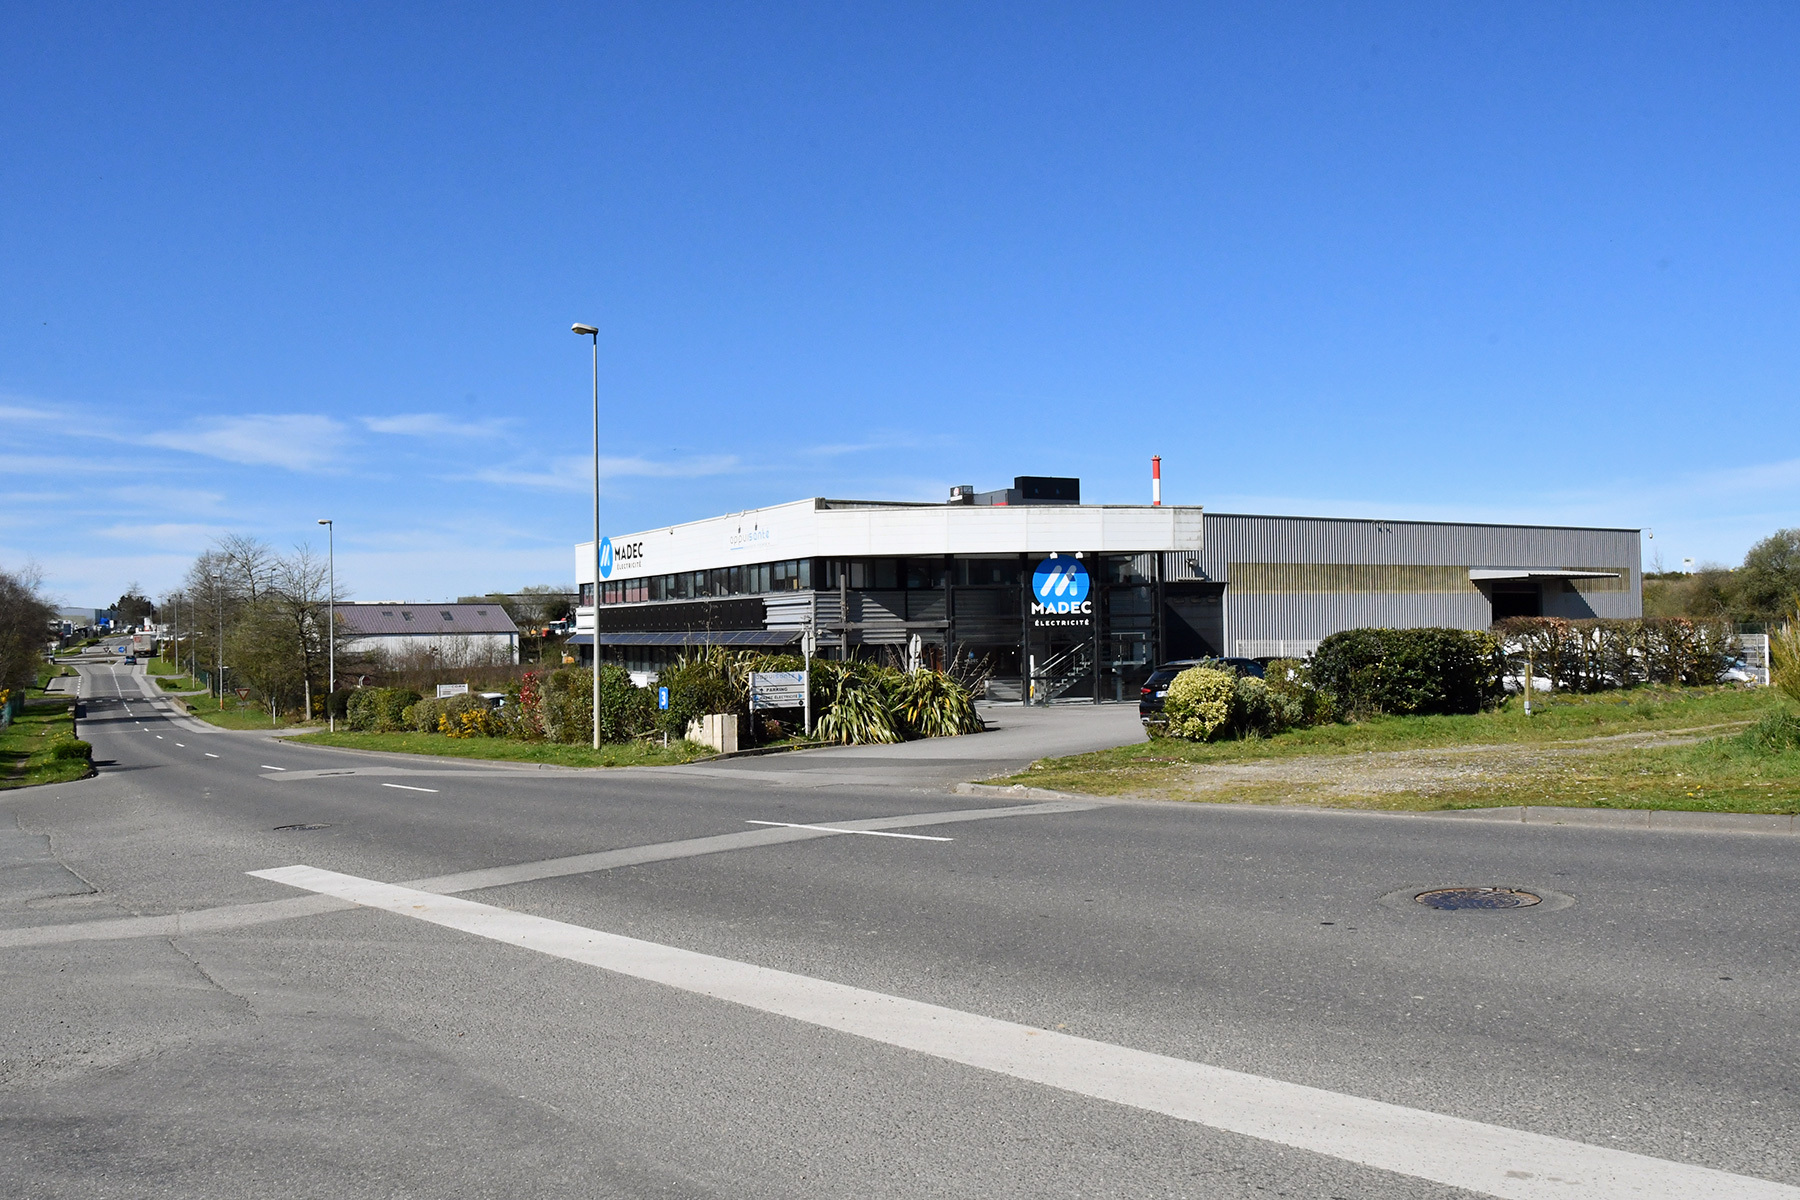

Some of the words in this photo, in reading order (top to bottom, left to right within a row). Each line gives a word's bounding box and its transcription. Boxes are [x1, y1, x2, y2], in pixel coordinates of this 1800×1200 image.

[614, 542, 643, 561] MADEC
[1031, 601, 1092, 615] MADEC
[1034, 619, 1090, 627] ÉLECTRICITÉ
[661, 691, 667, 705] 3
